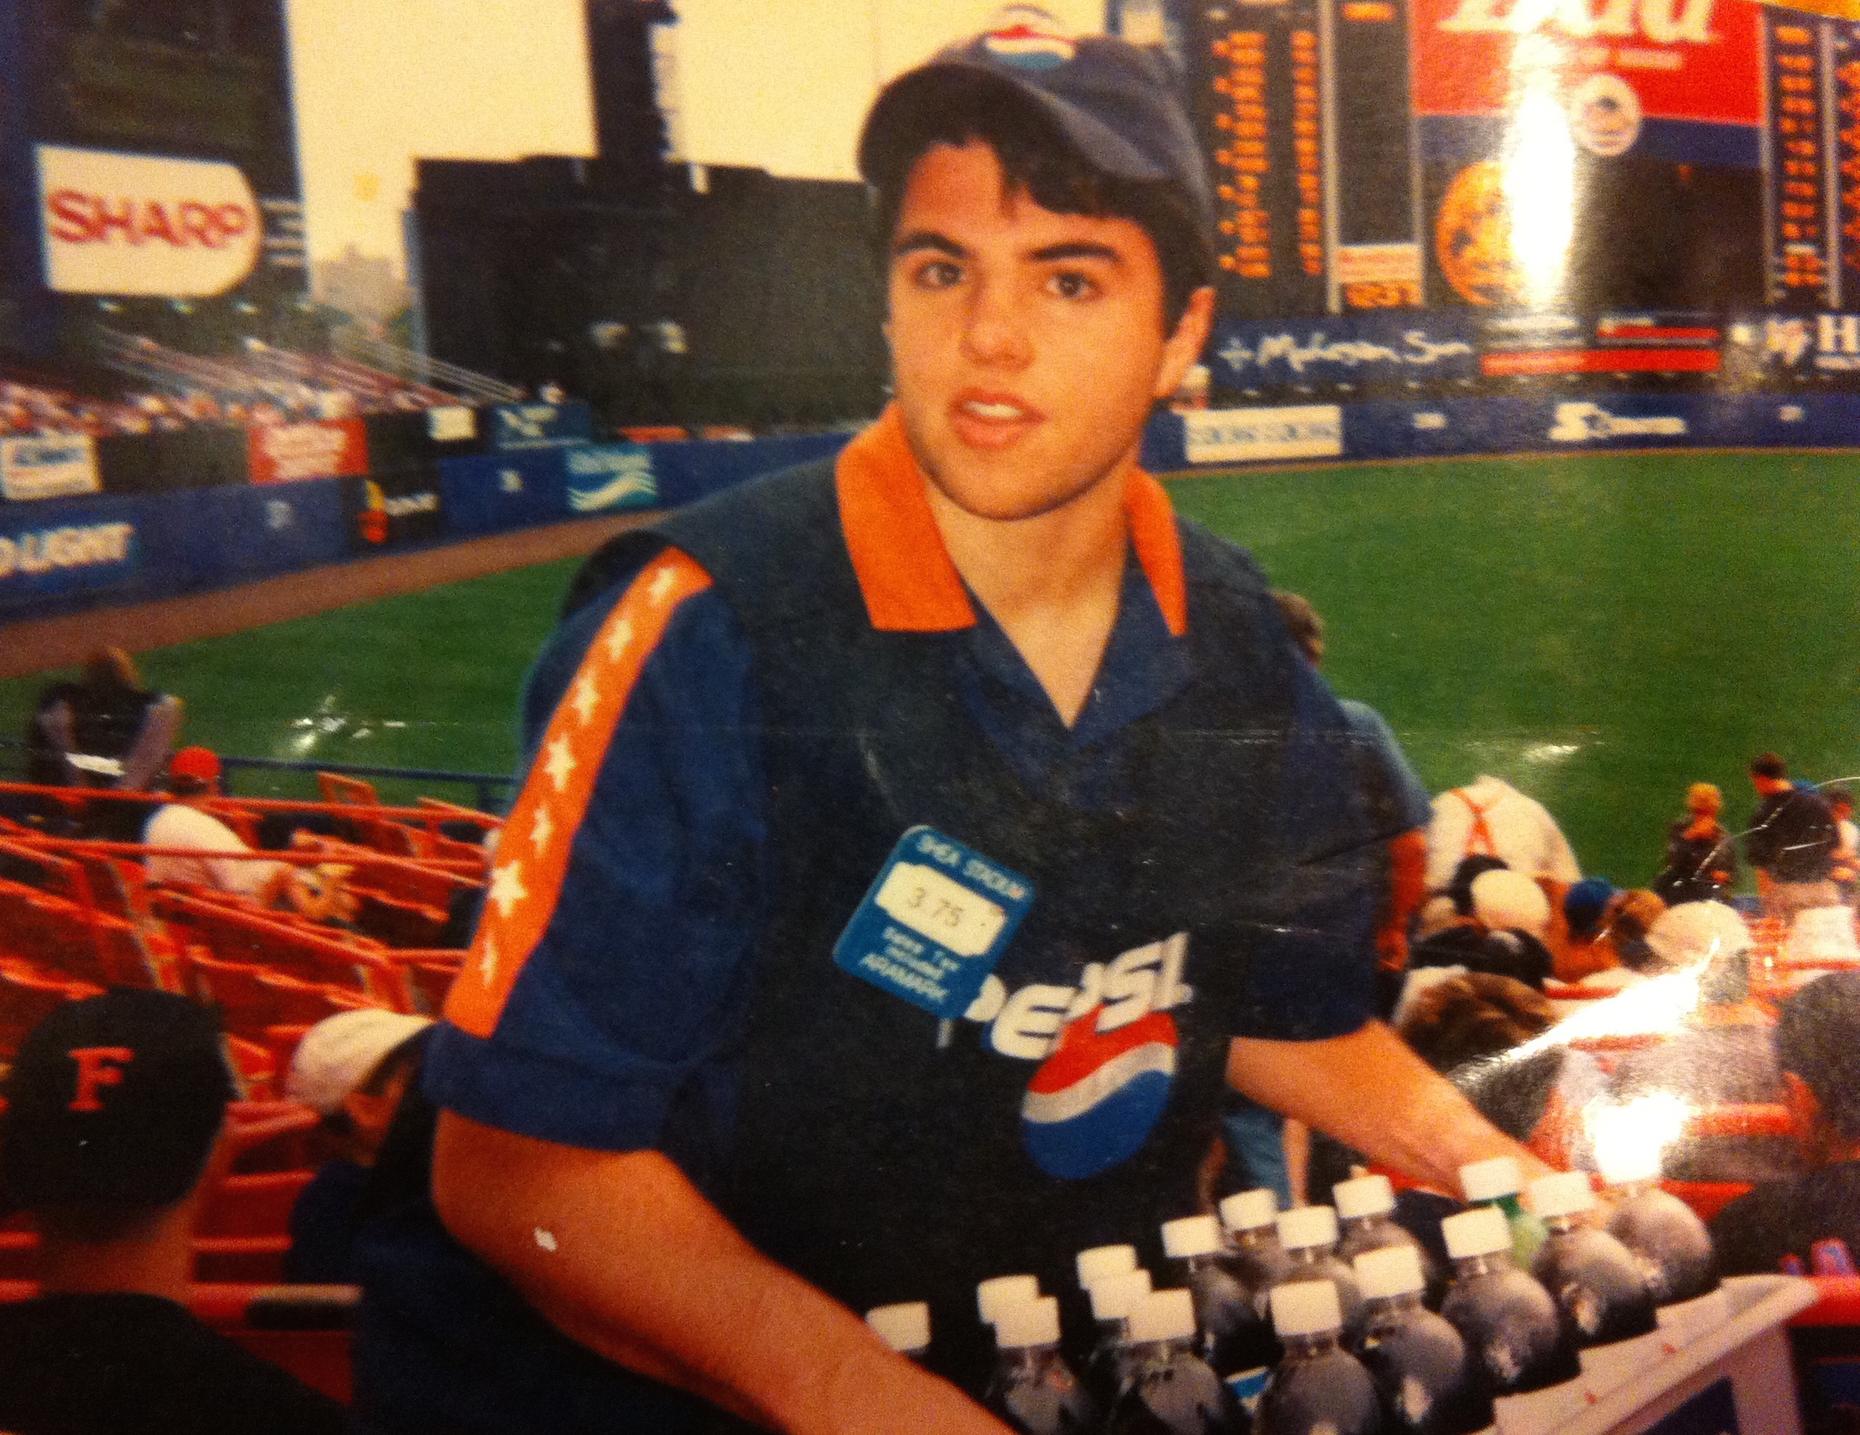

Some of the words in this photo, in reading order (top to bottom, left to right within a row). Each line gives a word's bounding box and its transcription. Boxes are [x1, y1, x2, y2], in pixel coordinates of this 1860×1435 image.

[47, 188, 248, 248] SHARP
[917, 834, 961, 867] SHEA
[962, 859, 1027, 899] STADIUM
[858, 953, 949, 1003] ARAMARK
[68, 1046, 135, 1112] F
